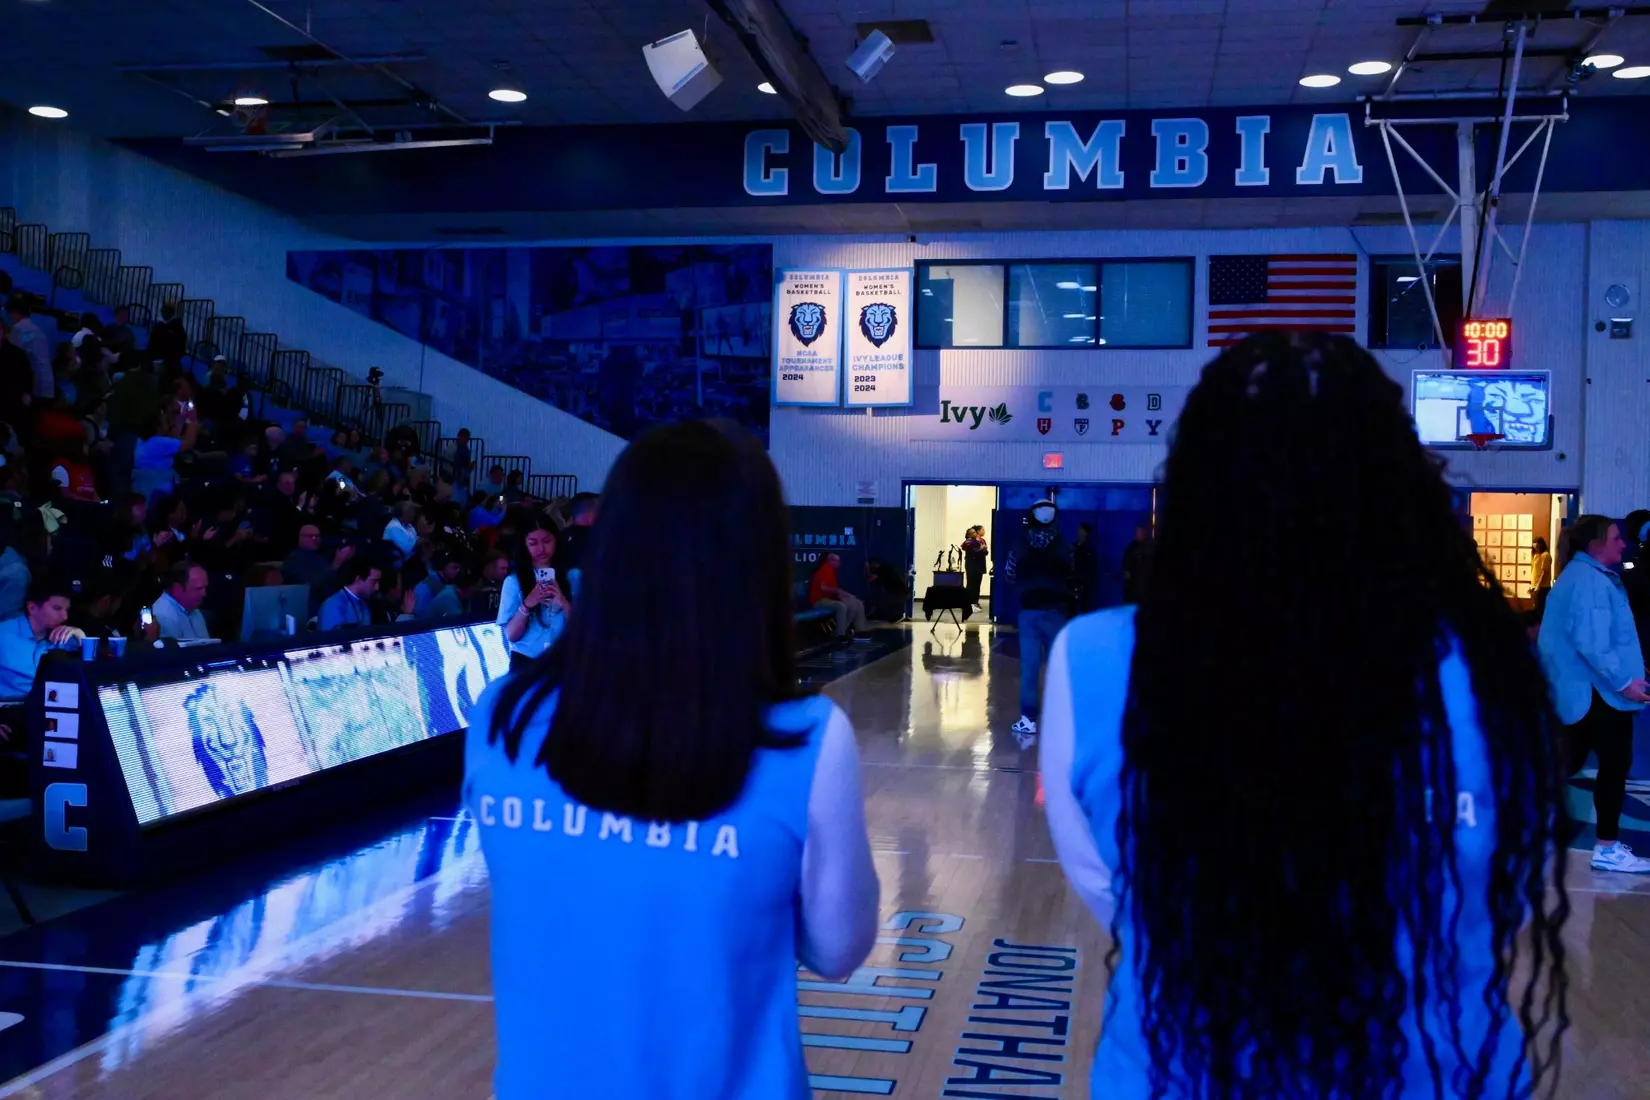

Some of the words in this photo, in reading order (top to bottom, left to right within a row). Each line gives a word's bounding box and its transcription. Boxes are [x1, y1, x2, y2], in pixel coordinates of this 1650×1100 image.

[743, 113, 1364, 197] COLUMBIA
[1464, 322, 1508, 338] 10:00
[869, 353, 904, 362] LEAGUE
[1467, 339, 1500, 366] 30
[852, 363, 904, 371] CHAMPIONS
[782, 373, 804, 381] 2024
[854, 375, 876, 383] 2023
[854, 384, 876, 392] 2024
[940, 400, 987, 430] Ivy
[1111, 419, 1125, 436] P
[1146, 419, 1162, 436] Y
[794, 533, 857, 546] LUMBIA
[795, 552, 821, 562] LIO
[44, 782, 88, 852] C
[480, 794, 739, 858] COLUMBIA
[943, 938, 1077, 1100] JONATHA
